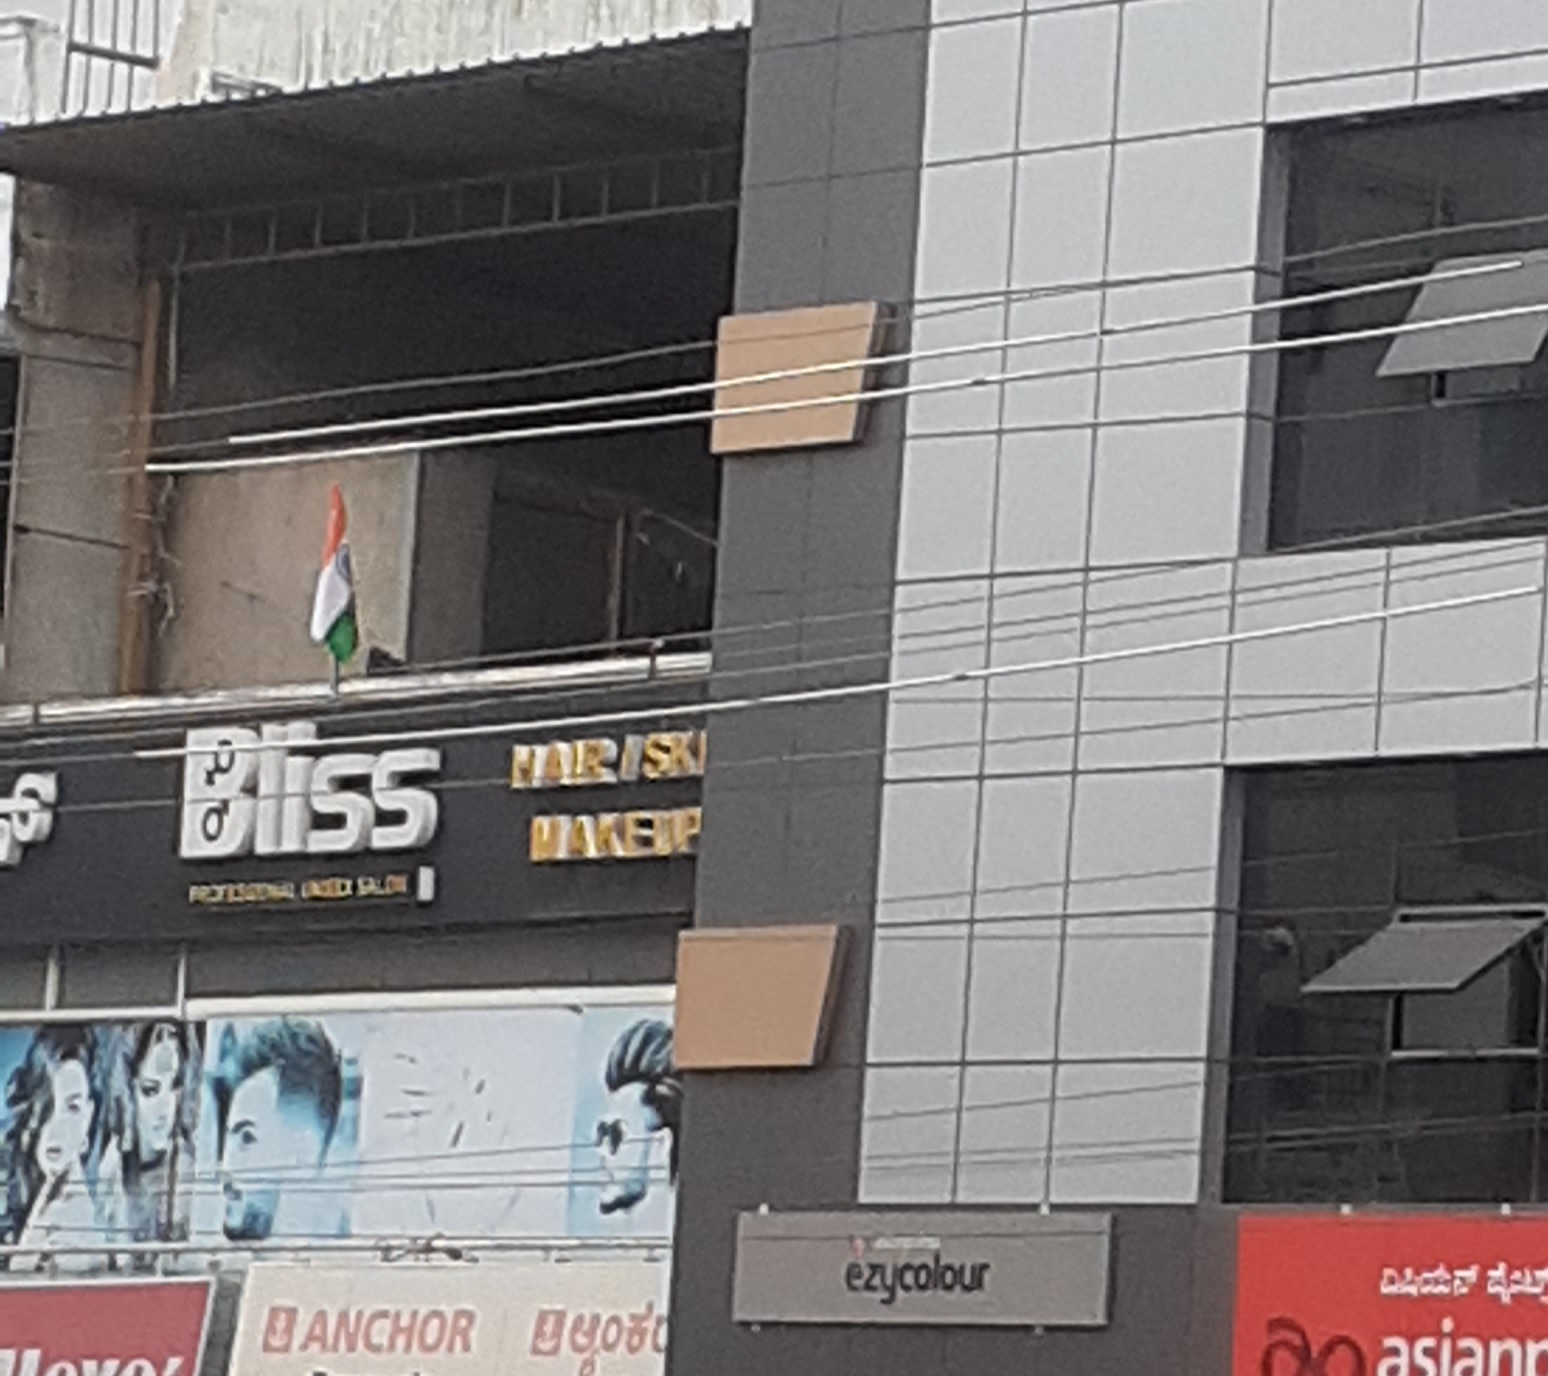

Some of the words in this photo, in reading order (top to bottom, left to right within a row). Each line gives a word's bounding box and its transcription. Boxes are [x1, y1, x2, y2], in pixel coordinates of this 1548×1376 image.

[180, 721, 440, 858] Bliss
[846, 1250, 991, 1305] ezycolour
[299, 1308, 477, 1354] ANCHOR
